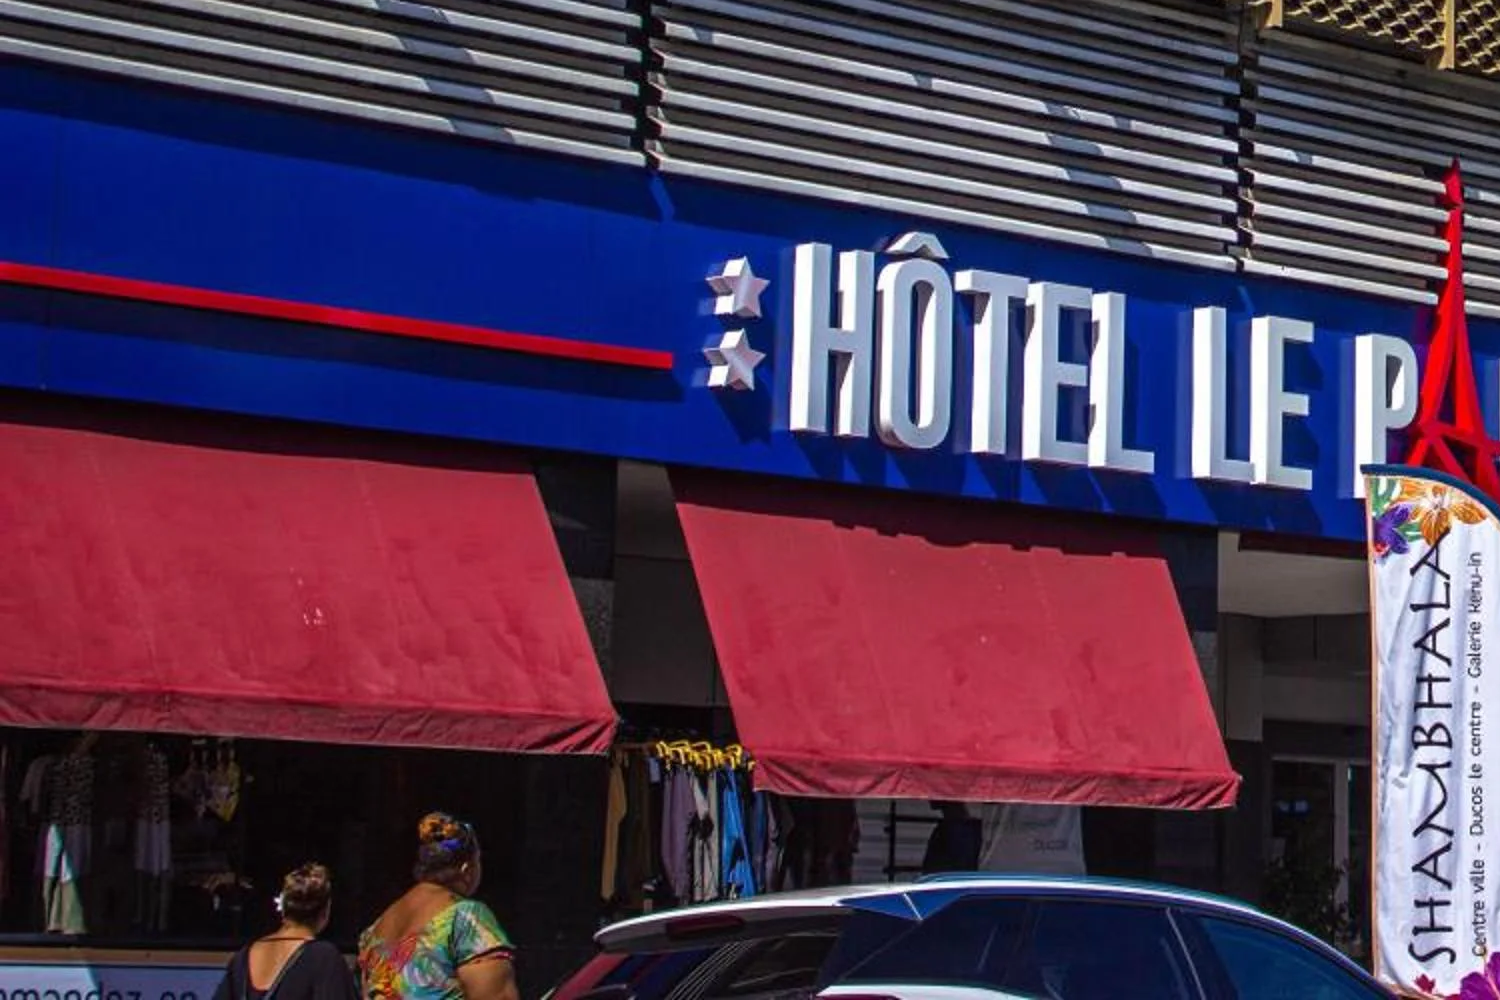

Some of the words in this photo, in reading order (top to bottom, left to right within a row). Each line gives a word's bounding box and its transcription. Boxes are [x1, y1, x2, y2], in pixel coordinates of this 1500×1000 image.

[788, 231, 1155, 474] HÔTEL
[1191, 306, 1315, 491] LE
[1466, 620, 1482, 679] Galerie
[1407, 526, 1457, 965] SHAMBHALA
[1469, 701, 1483, 757] centre
[1467, 763, 1483, 780] le
[1468, 785, 1485, 837] Ducos
[1469, 859, 1486, 895] ville
[1471, 900, 1487, 958] Centre
